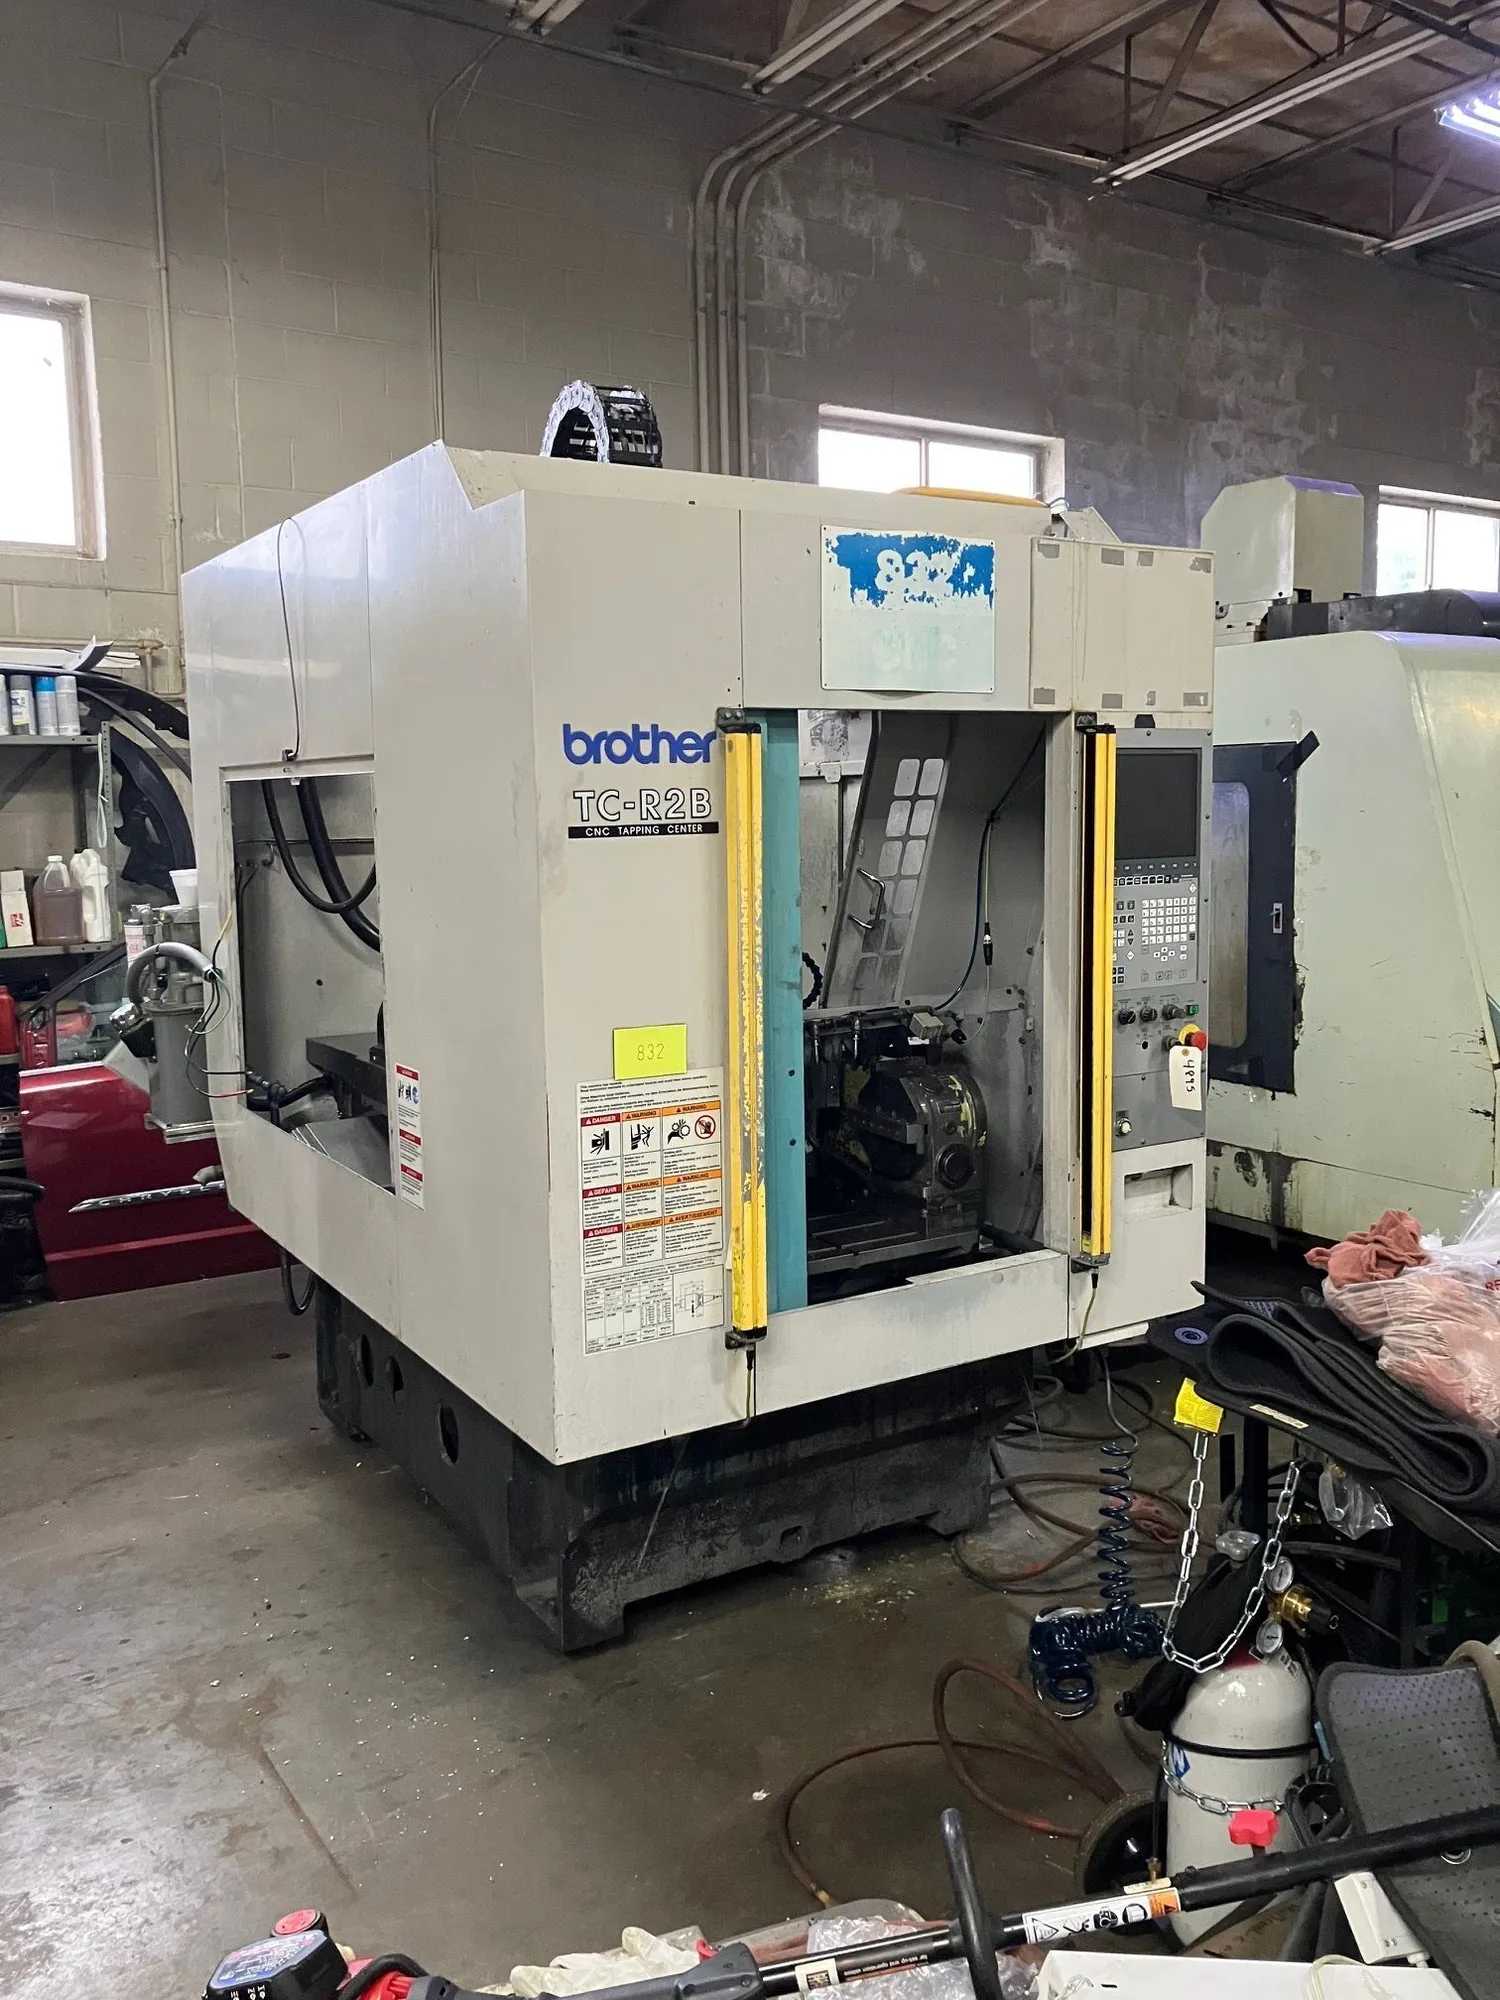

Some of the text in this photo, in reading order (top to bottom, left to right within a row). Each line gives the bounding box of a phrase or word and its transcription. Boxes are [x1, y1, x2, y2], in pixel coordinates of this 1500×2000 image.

[562, 723, 717, 765] brother
[573, 788, 712, 822] TC-R2B
[585, 824, 703, 837] CNC TAPPING CENTER
[637, 1042, 665, 1061] 832
[682, 1103, 707, 1112] WARNING
[592, 1114, 616, 1124] DANGER
[631, 1110, 657, 1119] WARNING
